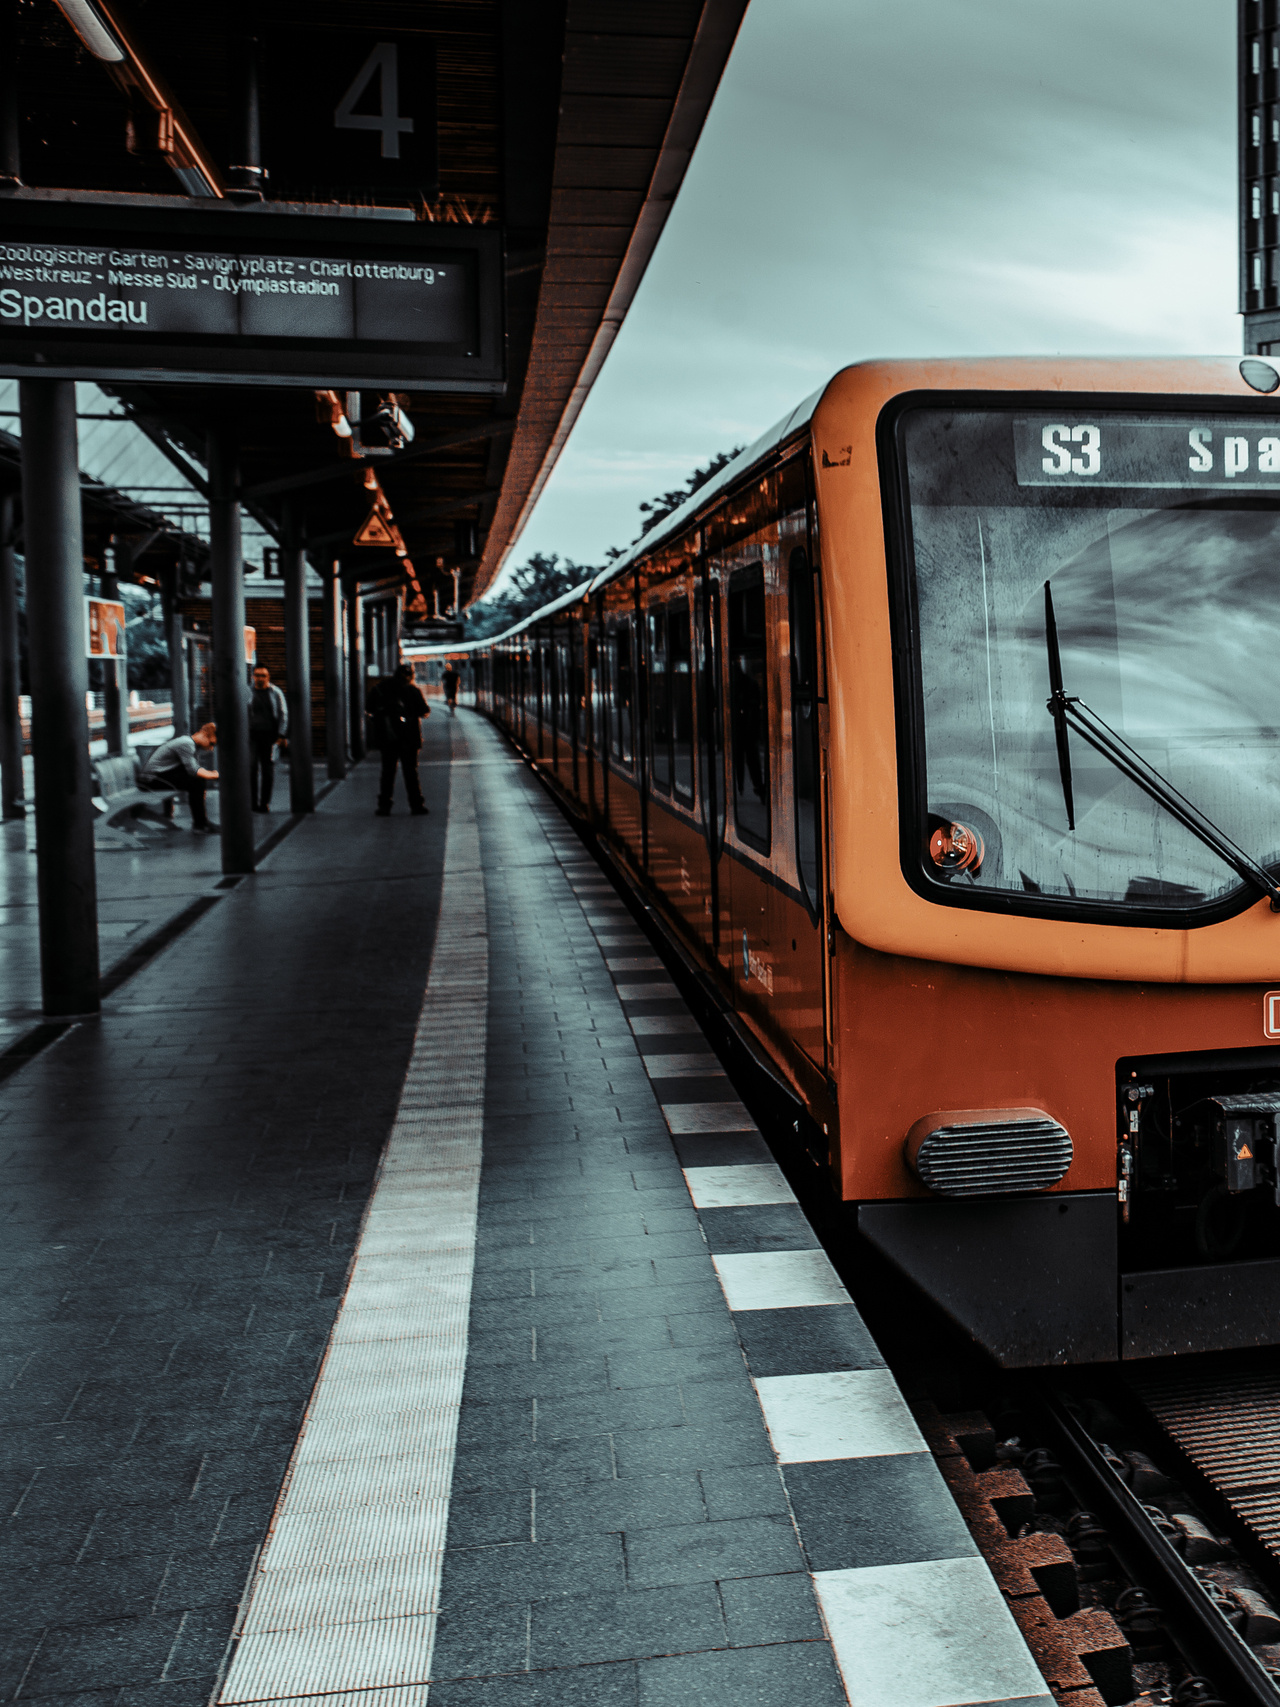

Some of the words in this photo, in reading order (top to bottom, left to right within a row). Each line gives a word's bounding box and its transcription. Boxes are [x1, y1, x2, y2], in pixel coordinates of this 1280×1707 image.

[334, 42, 414, 159] 4
[0, 245, 105, 267] Zoologischer
[109, 250, 169, 269] Garten
[184, 253, 295, 276] Savignyplatz
[309, 259, 435, 285] Charlottenburg
[0, 265, 92, 285] Westkreuz
[108, 269, 164, 288] Messe
[166, 271, 198, 290] Süd
[212, 274, 340, 297] Olympiastadion
[0, 289, 148, 327] Spandau
[1041, 424, 1101, 476] S3
